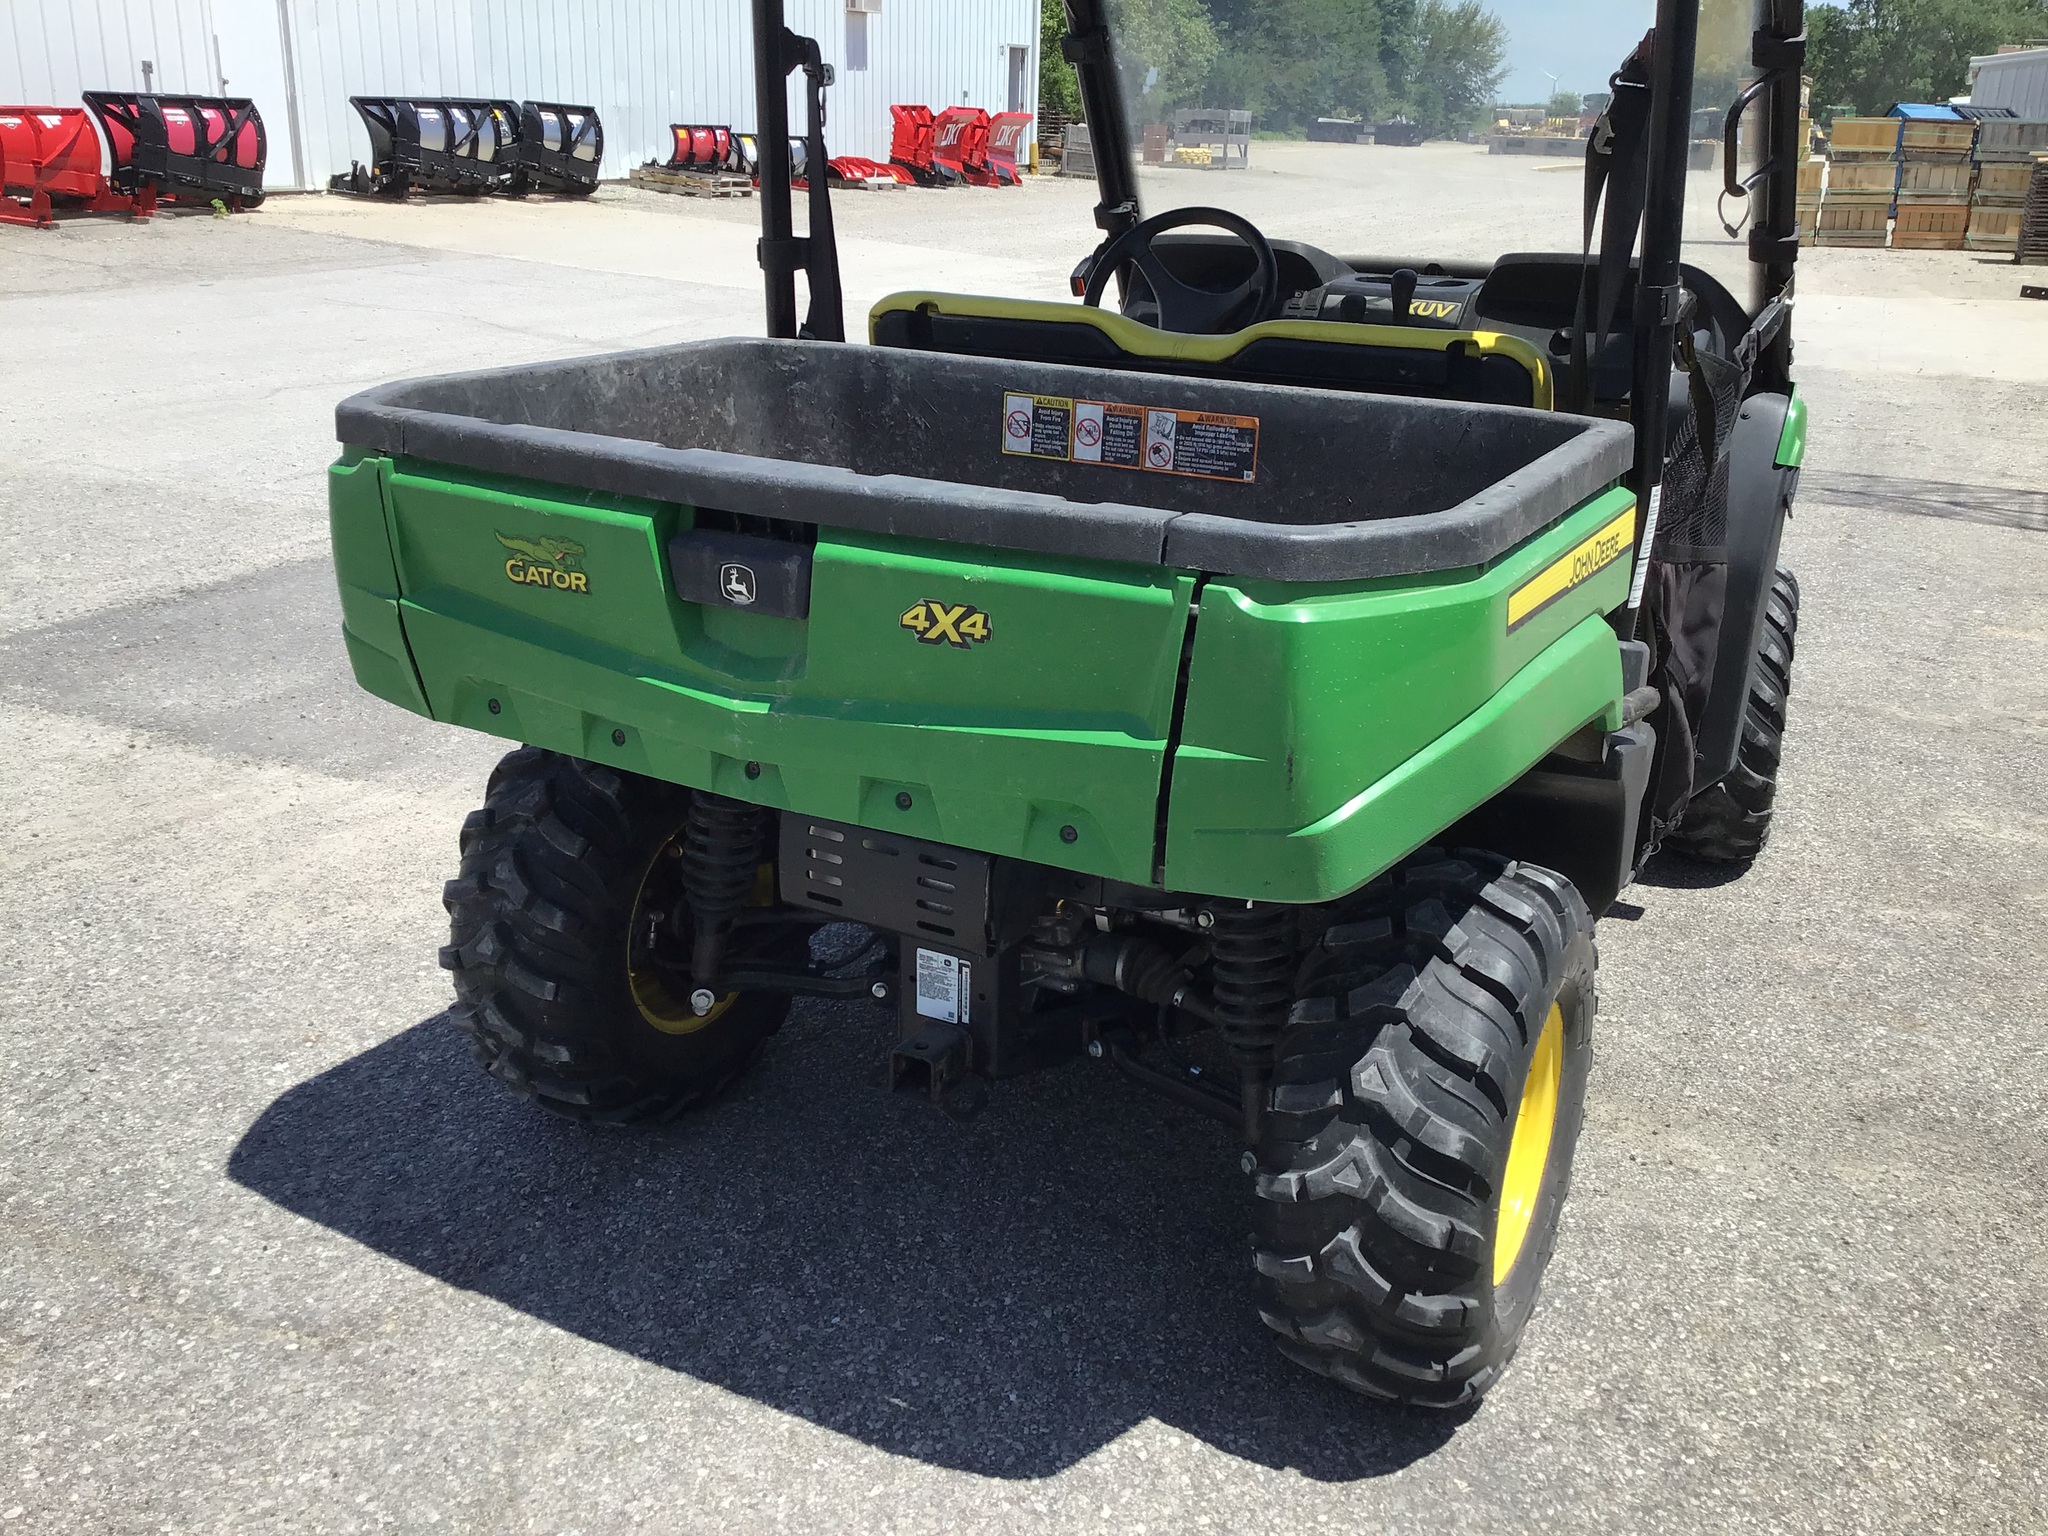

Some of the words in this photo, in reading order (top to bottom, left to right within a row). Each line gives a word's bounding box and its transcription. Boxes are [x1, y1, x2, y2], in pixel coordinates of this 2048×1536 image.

[994, 125, 1021, 146] DXT
[1043, 398, 1069, 407] CAUTION
[1113, 405, 1142, 415] WARNING
[1205, 414, 1236, 425] WARNING
[1568, 548, 1594, 584] JOHN
[1595, 532, 1620, 567] DEERE
[505, 559, 589, 593] GATOR
[901, 600, 990, 646] 4X4
